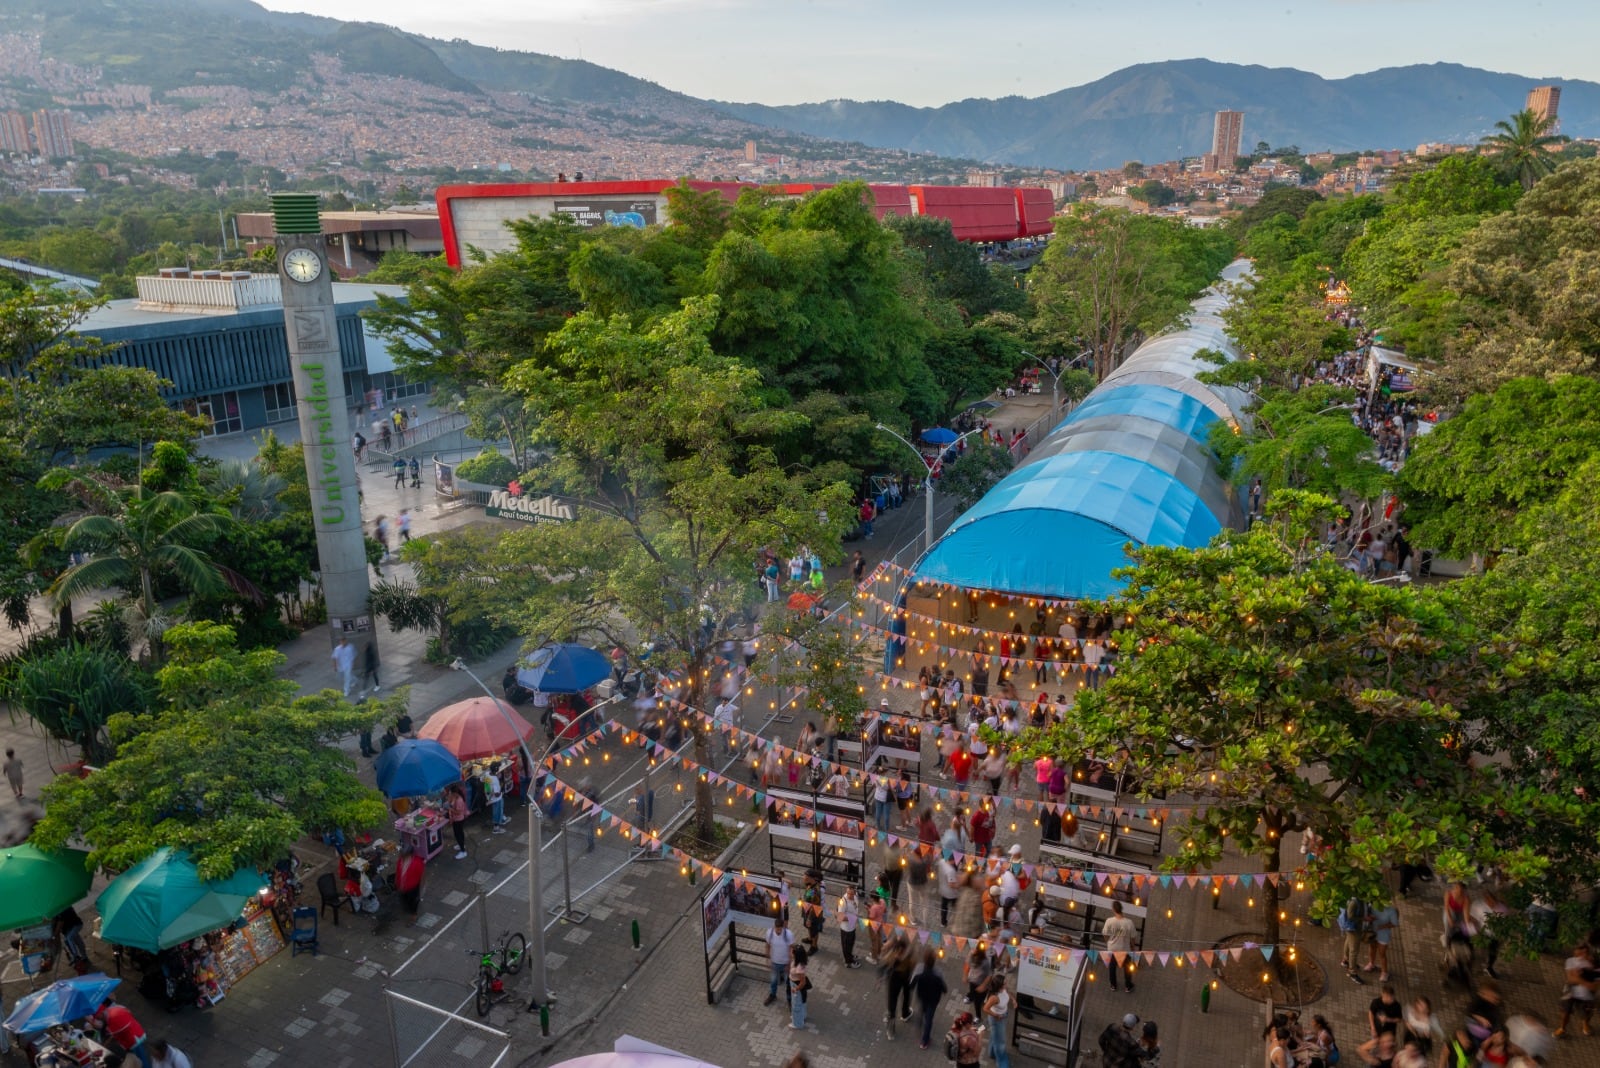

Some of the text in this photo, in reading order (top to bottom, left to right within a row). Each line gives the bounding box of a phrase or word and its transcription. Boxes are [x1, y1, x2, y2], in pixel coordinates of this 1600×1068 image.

[301, 363, 345, 525] Universidad
[487, 489, 573, 520] Medellín
[499, 510, 516, 519] Aquí
[516, 513, 533, 521] todo
